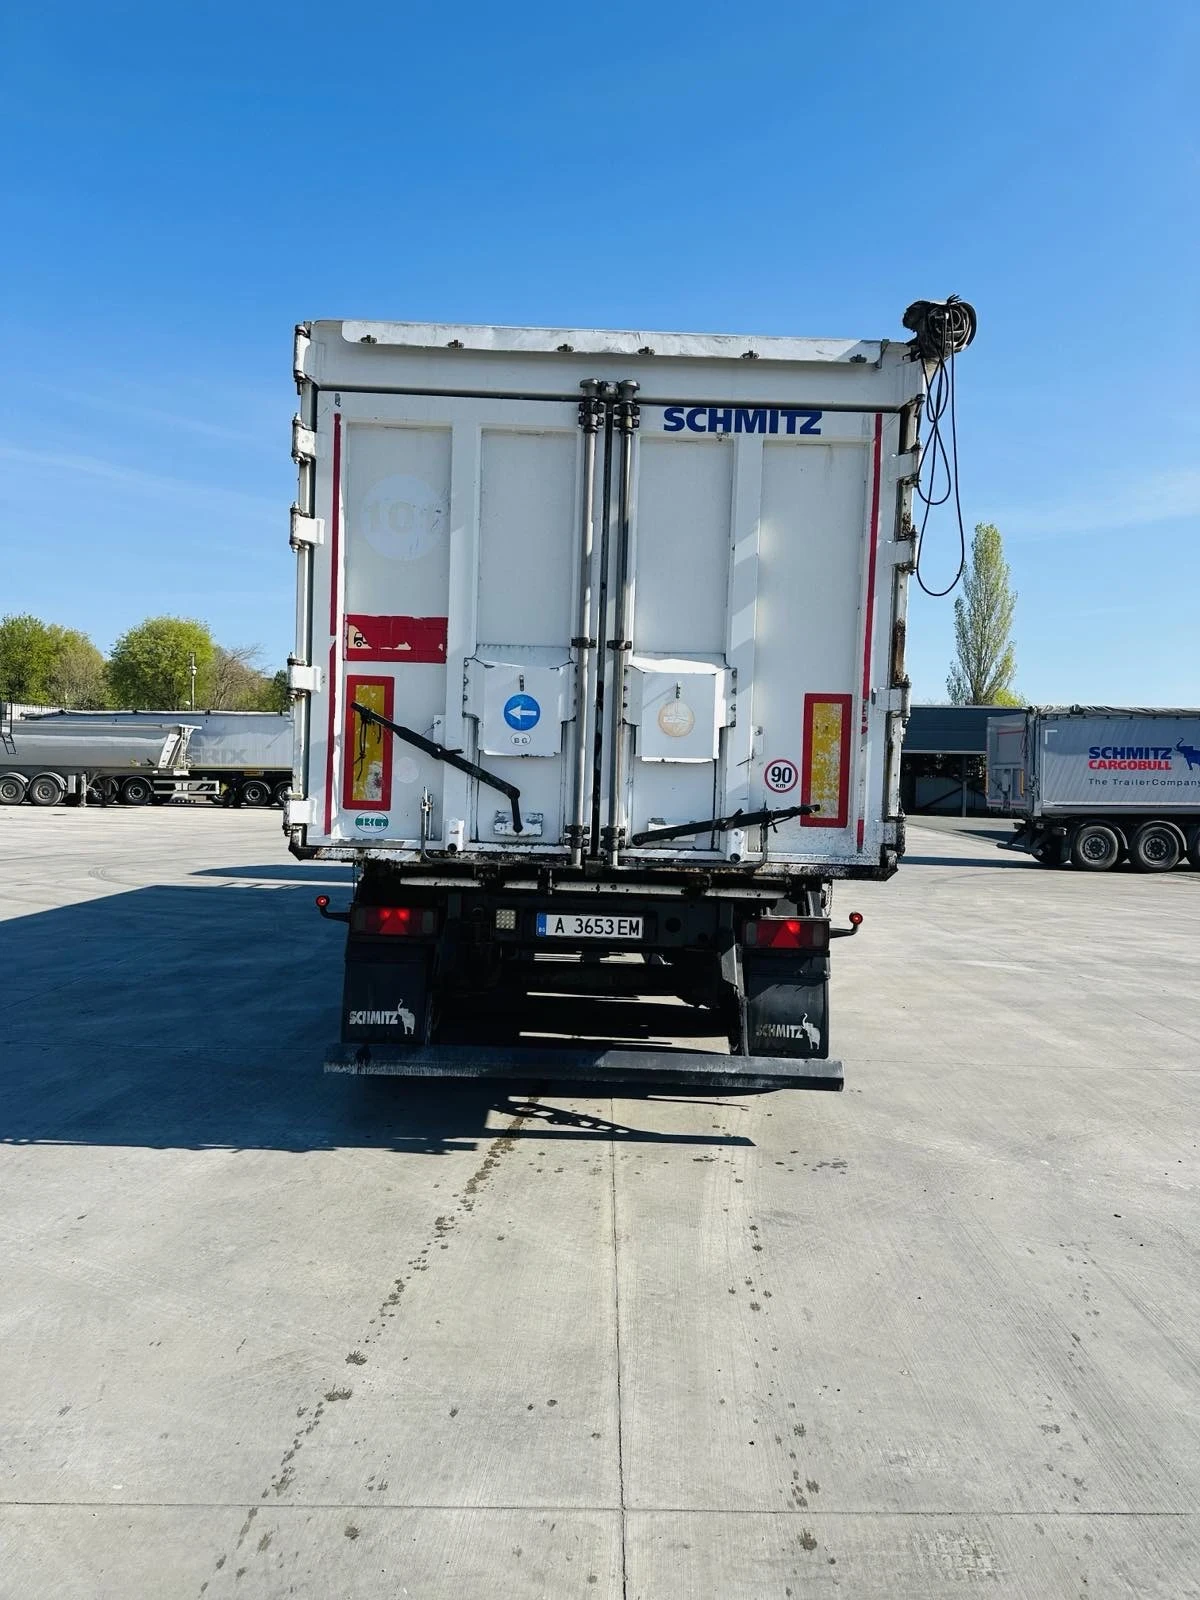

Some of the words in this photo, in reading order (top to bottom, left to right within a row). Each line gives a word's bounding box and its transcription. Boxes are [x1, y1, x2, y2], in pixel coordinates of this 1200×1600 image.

[663, 407, 822, 434] SCHMITZ
[1089, 747, 1172, 759] SCHMITZ
[1089, 760, 1172, 770] CARGOBULL
[771, 766, 792, 783] 90
[1089, 778, 1108, 786] The
[555, 917, 565, 933] A
[574, 918, 614, 935] 3653
[618, 919, 640, 936] EM
[349, 1011, 398, 1024] SCHMITZ
